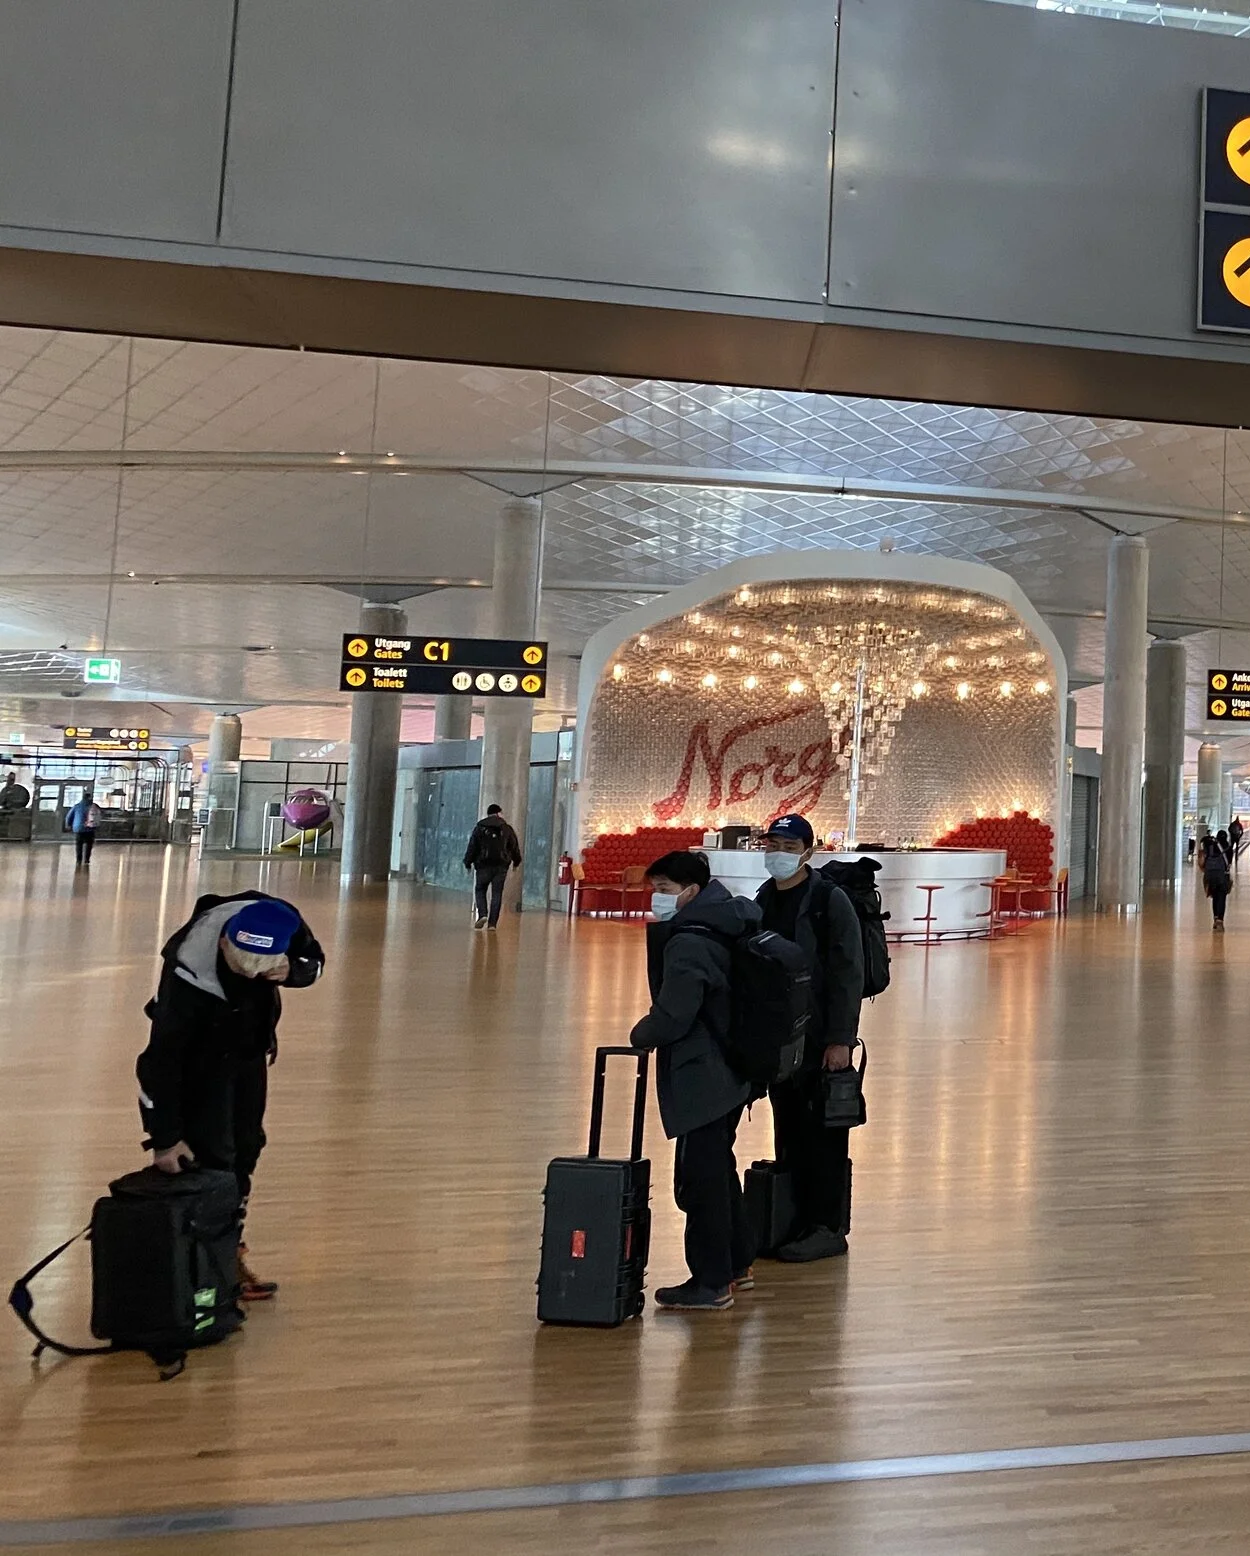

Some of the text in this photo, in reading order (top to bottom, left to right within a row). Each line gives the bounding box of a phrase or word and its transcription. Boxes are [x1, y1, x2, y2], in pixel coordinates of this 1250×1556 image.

[373, 648, 403, 659] Gates
[374, 638, 450, 661] Utgang C1
[372, 667, 408, 678] Toalett
[372, 678, 405, 689] Toilets
